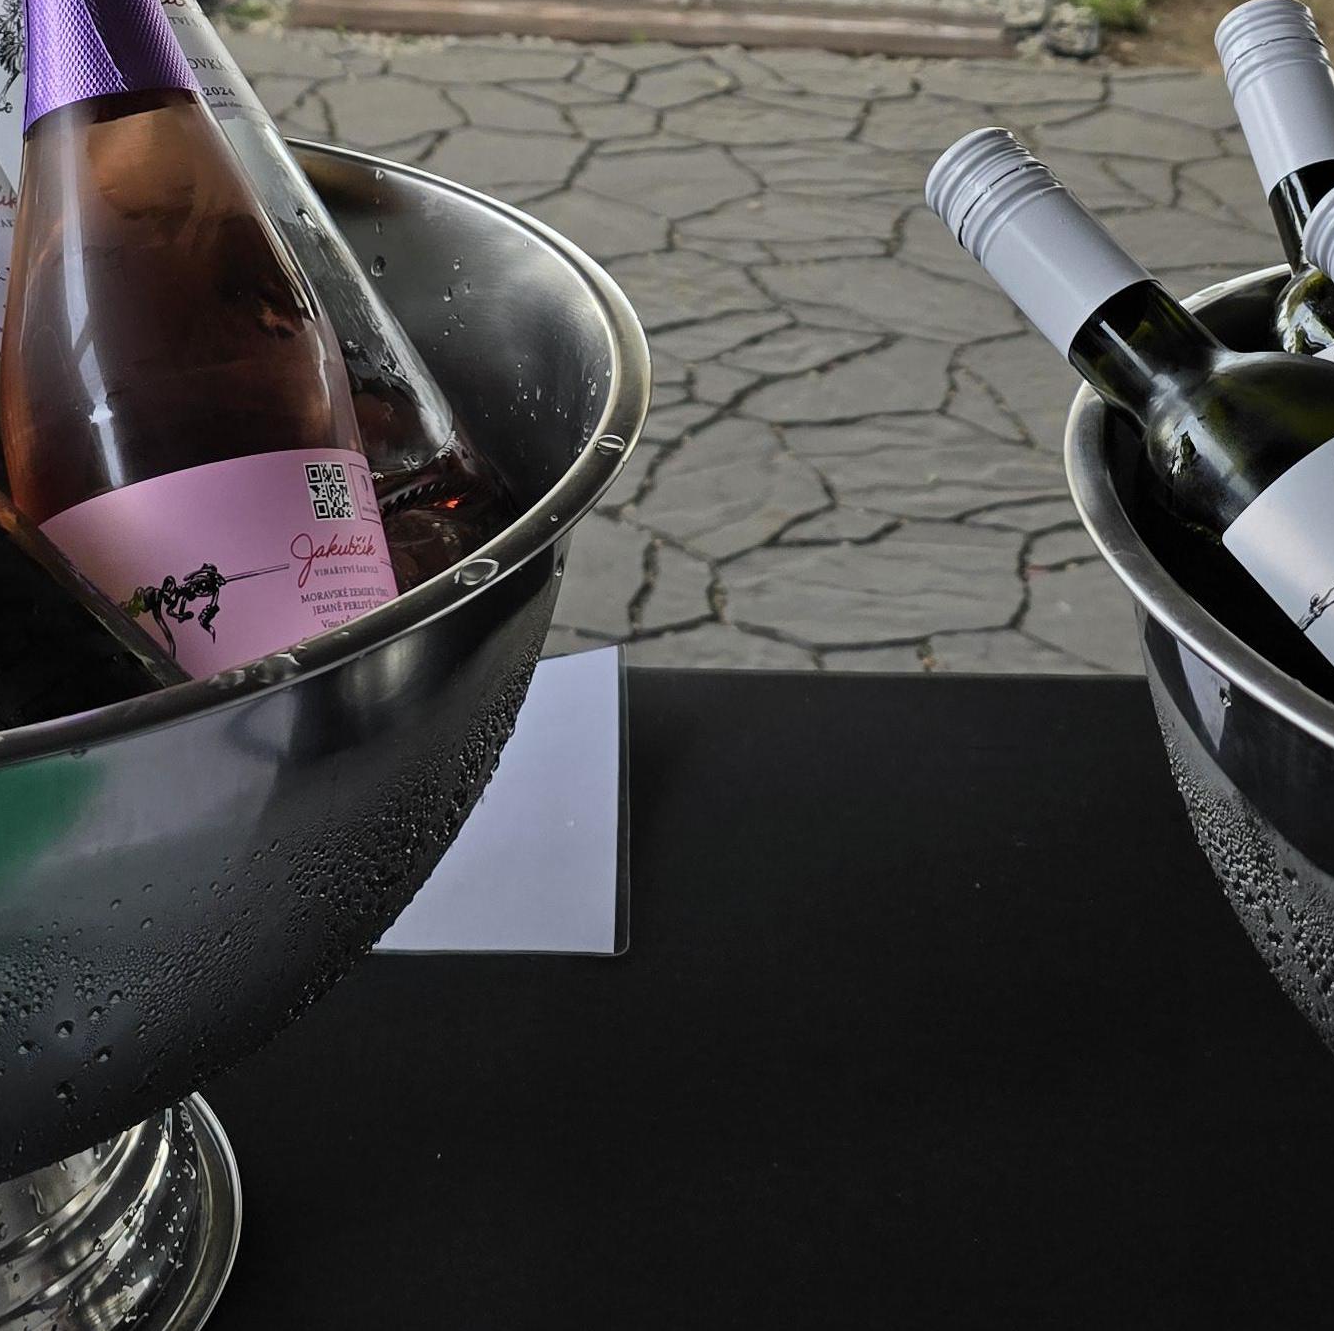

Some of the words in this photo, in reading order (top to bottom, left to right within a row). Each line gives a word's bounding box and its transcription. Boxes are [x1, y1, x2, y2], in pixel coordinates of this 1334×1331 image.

[290, 533, 377, 588] Jakubčík
[300, 586, 348, 604] MORAVSKÉ
[311, 599, 343, 617] JEMNÉ
